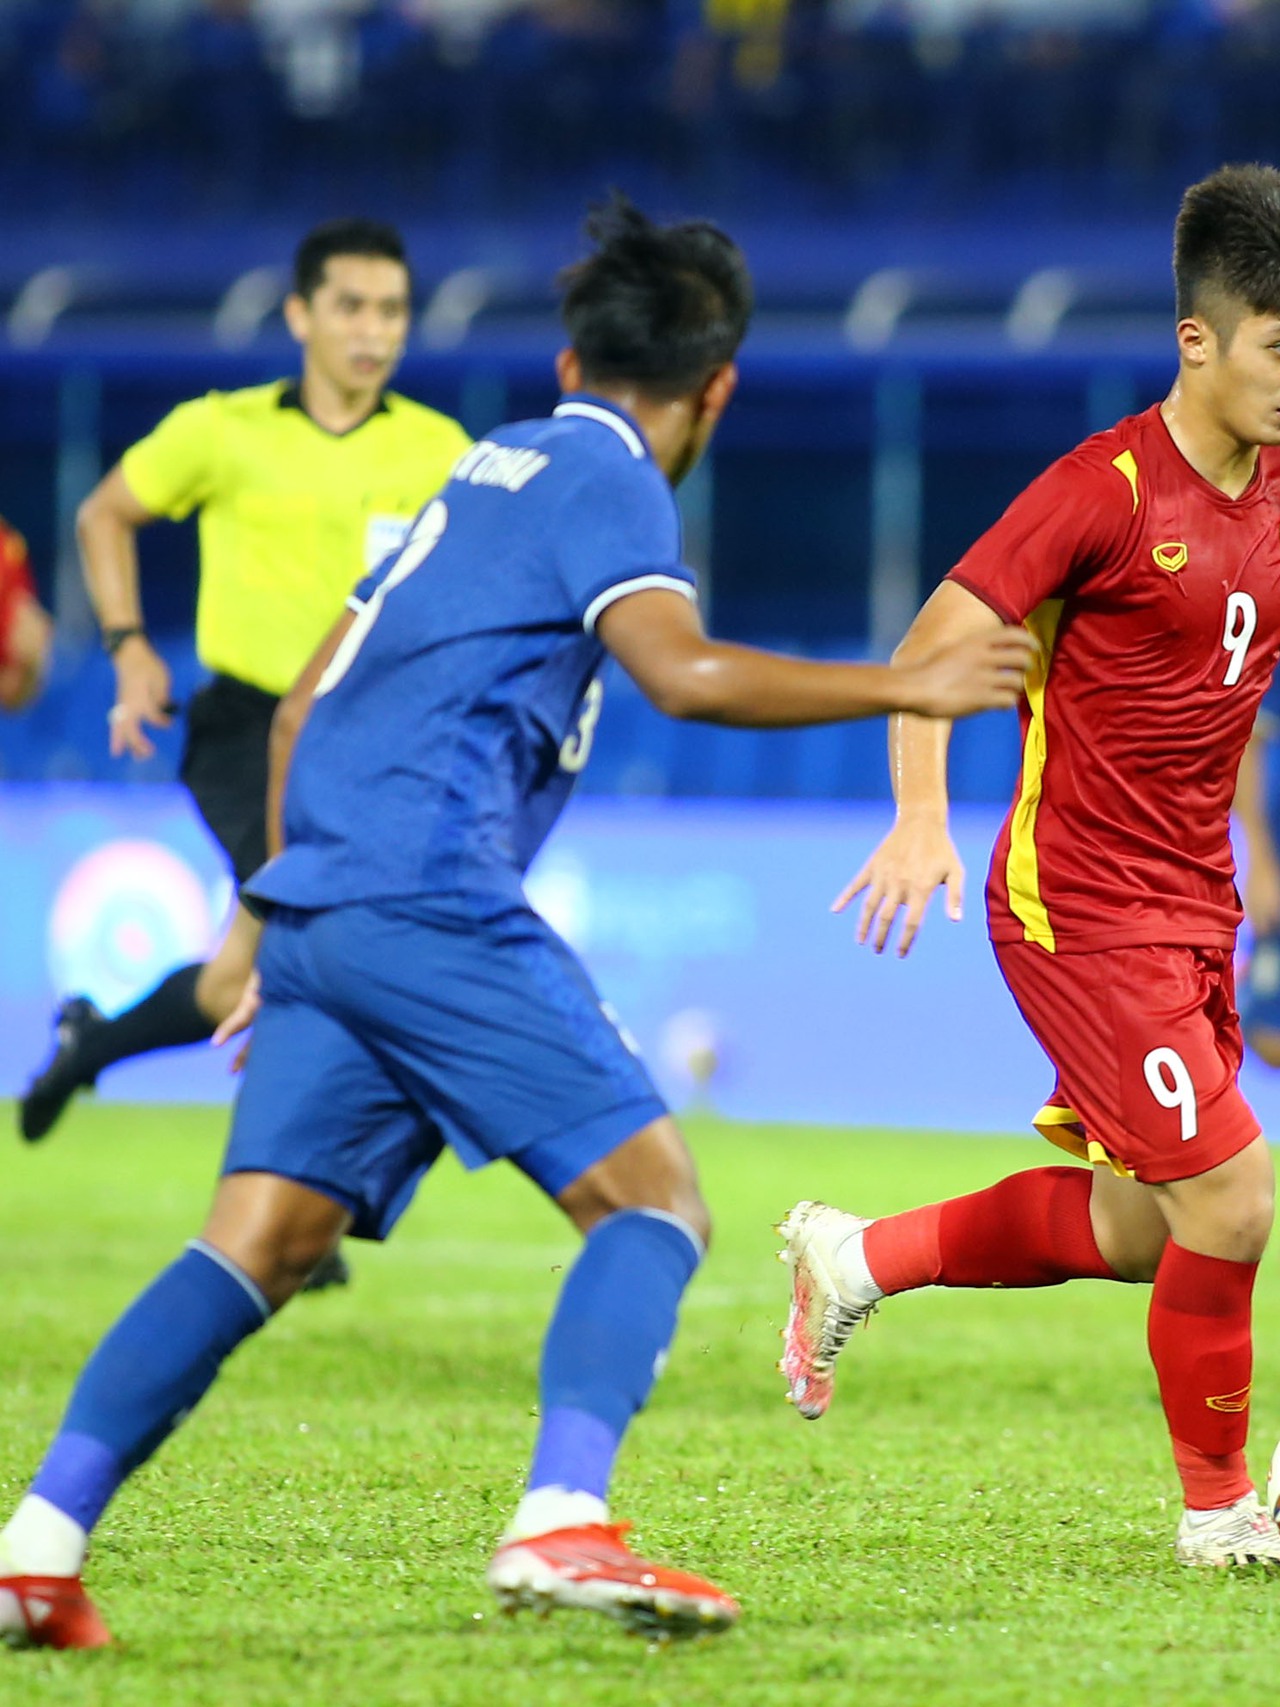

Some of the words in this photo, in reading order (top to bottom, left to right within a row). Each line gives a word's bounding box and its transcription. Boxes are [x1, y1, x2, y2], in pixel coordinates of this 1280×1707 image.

[1222, 591, 1258, 686] 9
[558, 678, 604, 773] 3
[1143, 1046, 1198, 1141] 9
